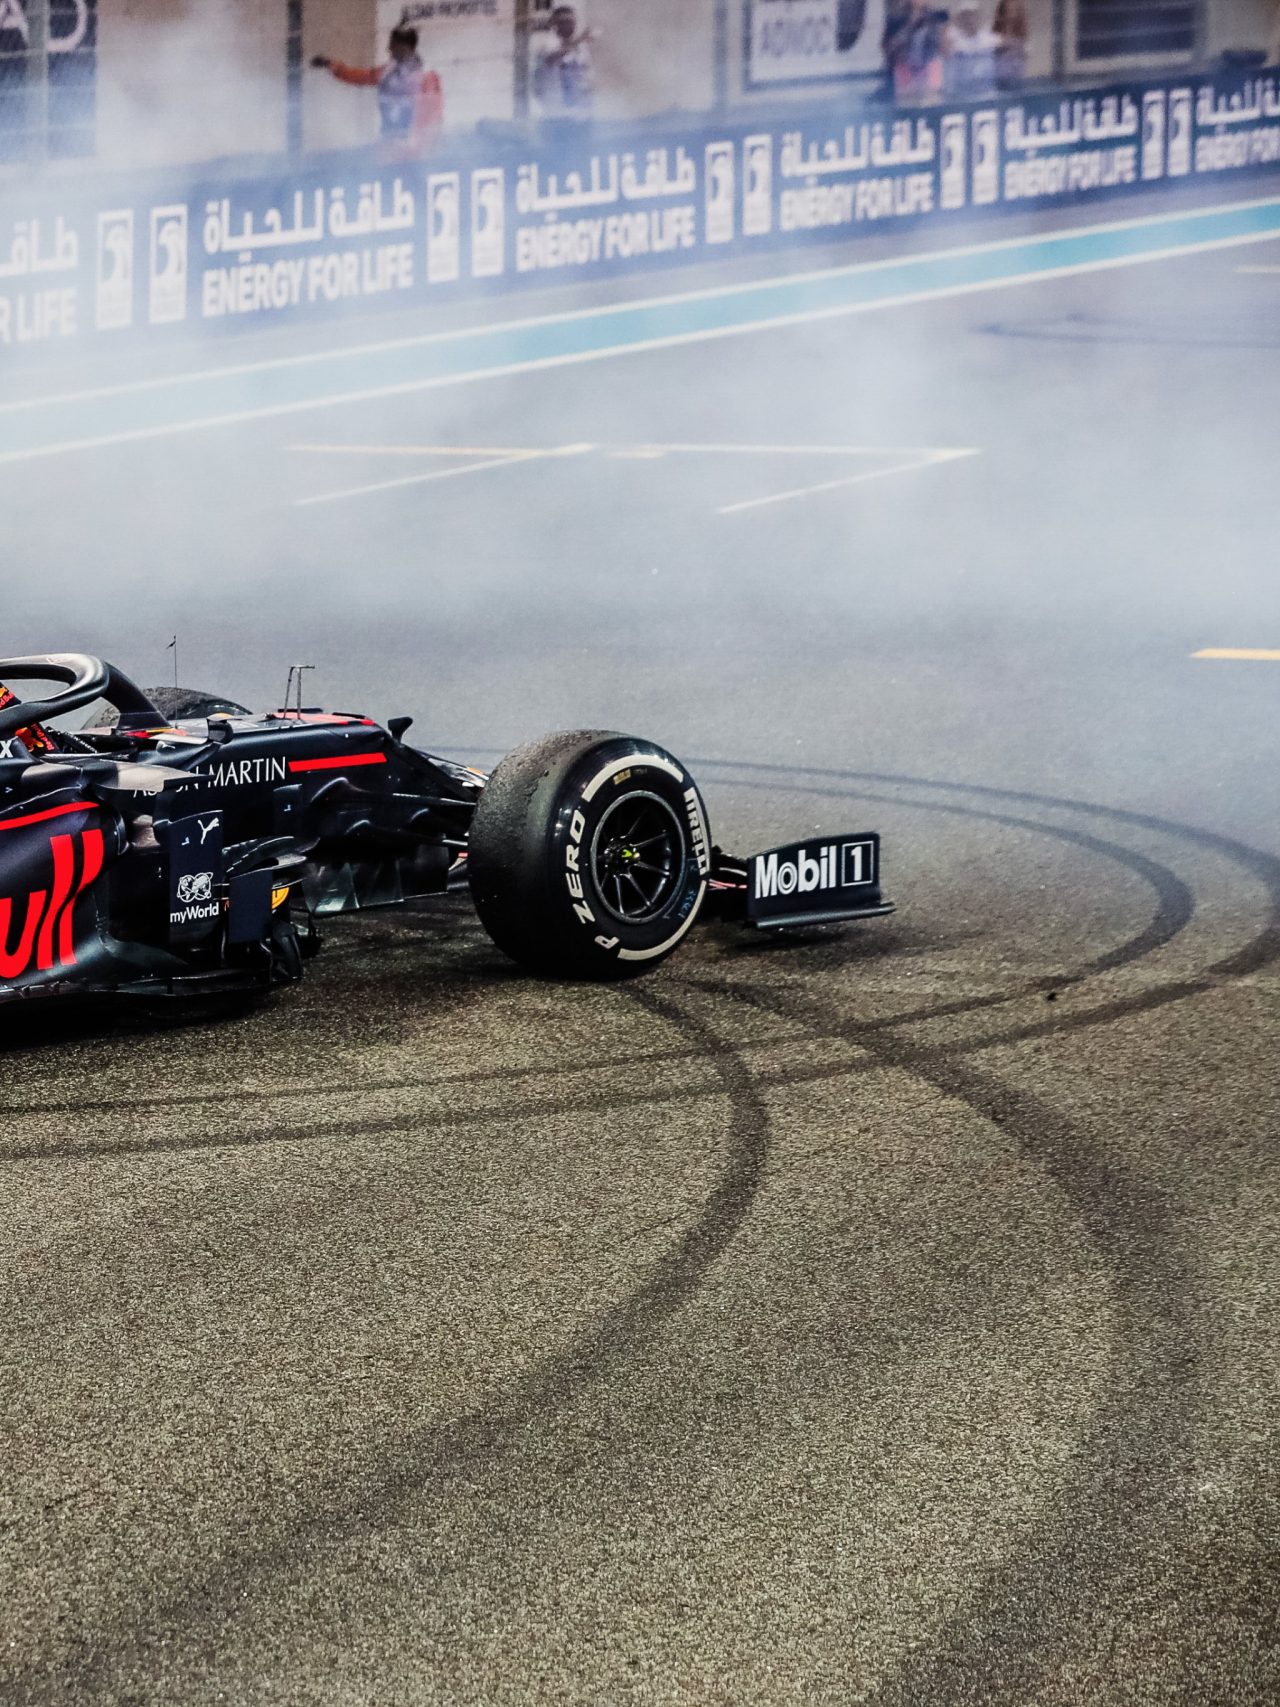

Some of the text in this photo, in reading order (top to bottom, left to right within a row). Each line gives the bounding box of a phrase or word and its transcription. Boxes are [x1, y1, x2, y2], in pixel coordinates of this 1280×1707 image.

[329, 178, 414, 237] طاقة
[855, 177, 893, 220] FOR
[894, 172, 933, 216] LIFE
[516, 216, 604, 272] ENERGY
[605, 211, 649, 259] FOR
[650, 204, 696, 253] LIFE
[203, 258, 305, 317] ENERGY
[308, 252, 357, 302] FOR
[362, 242, 414, 295] LIFE
[16, 288, 77, 341] LIFE
[207, 756, 286, 789] MARTIN
[683, 787, 711, 876] PIRELLI
[565, 809, 596, 924] ZERO
[755, 845, 862, 899] Mobil 1
[170, 902, 219, 924] myWorld
